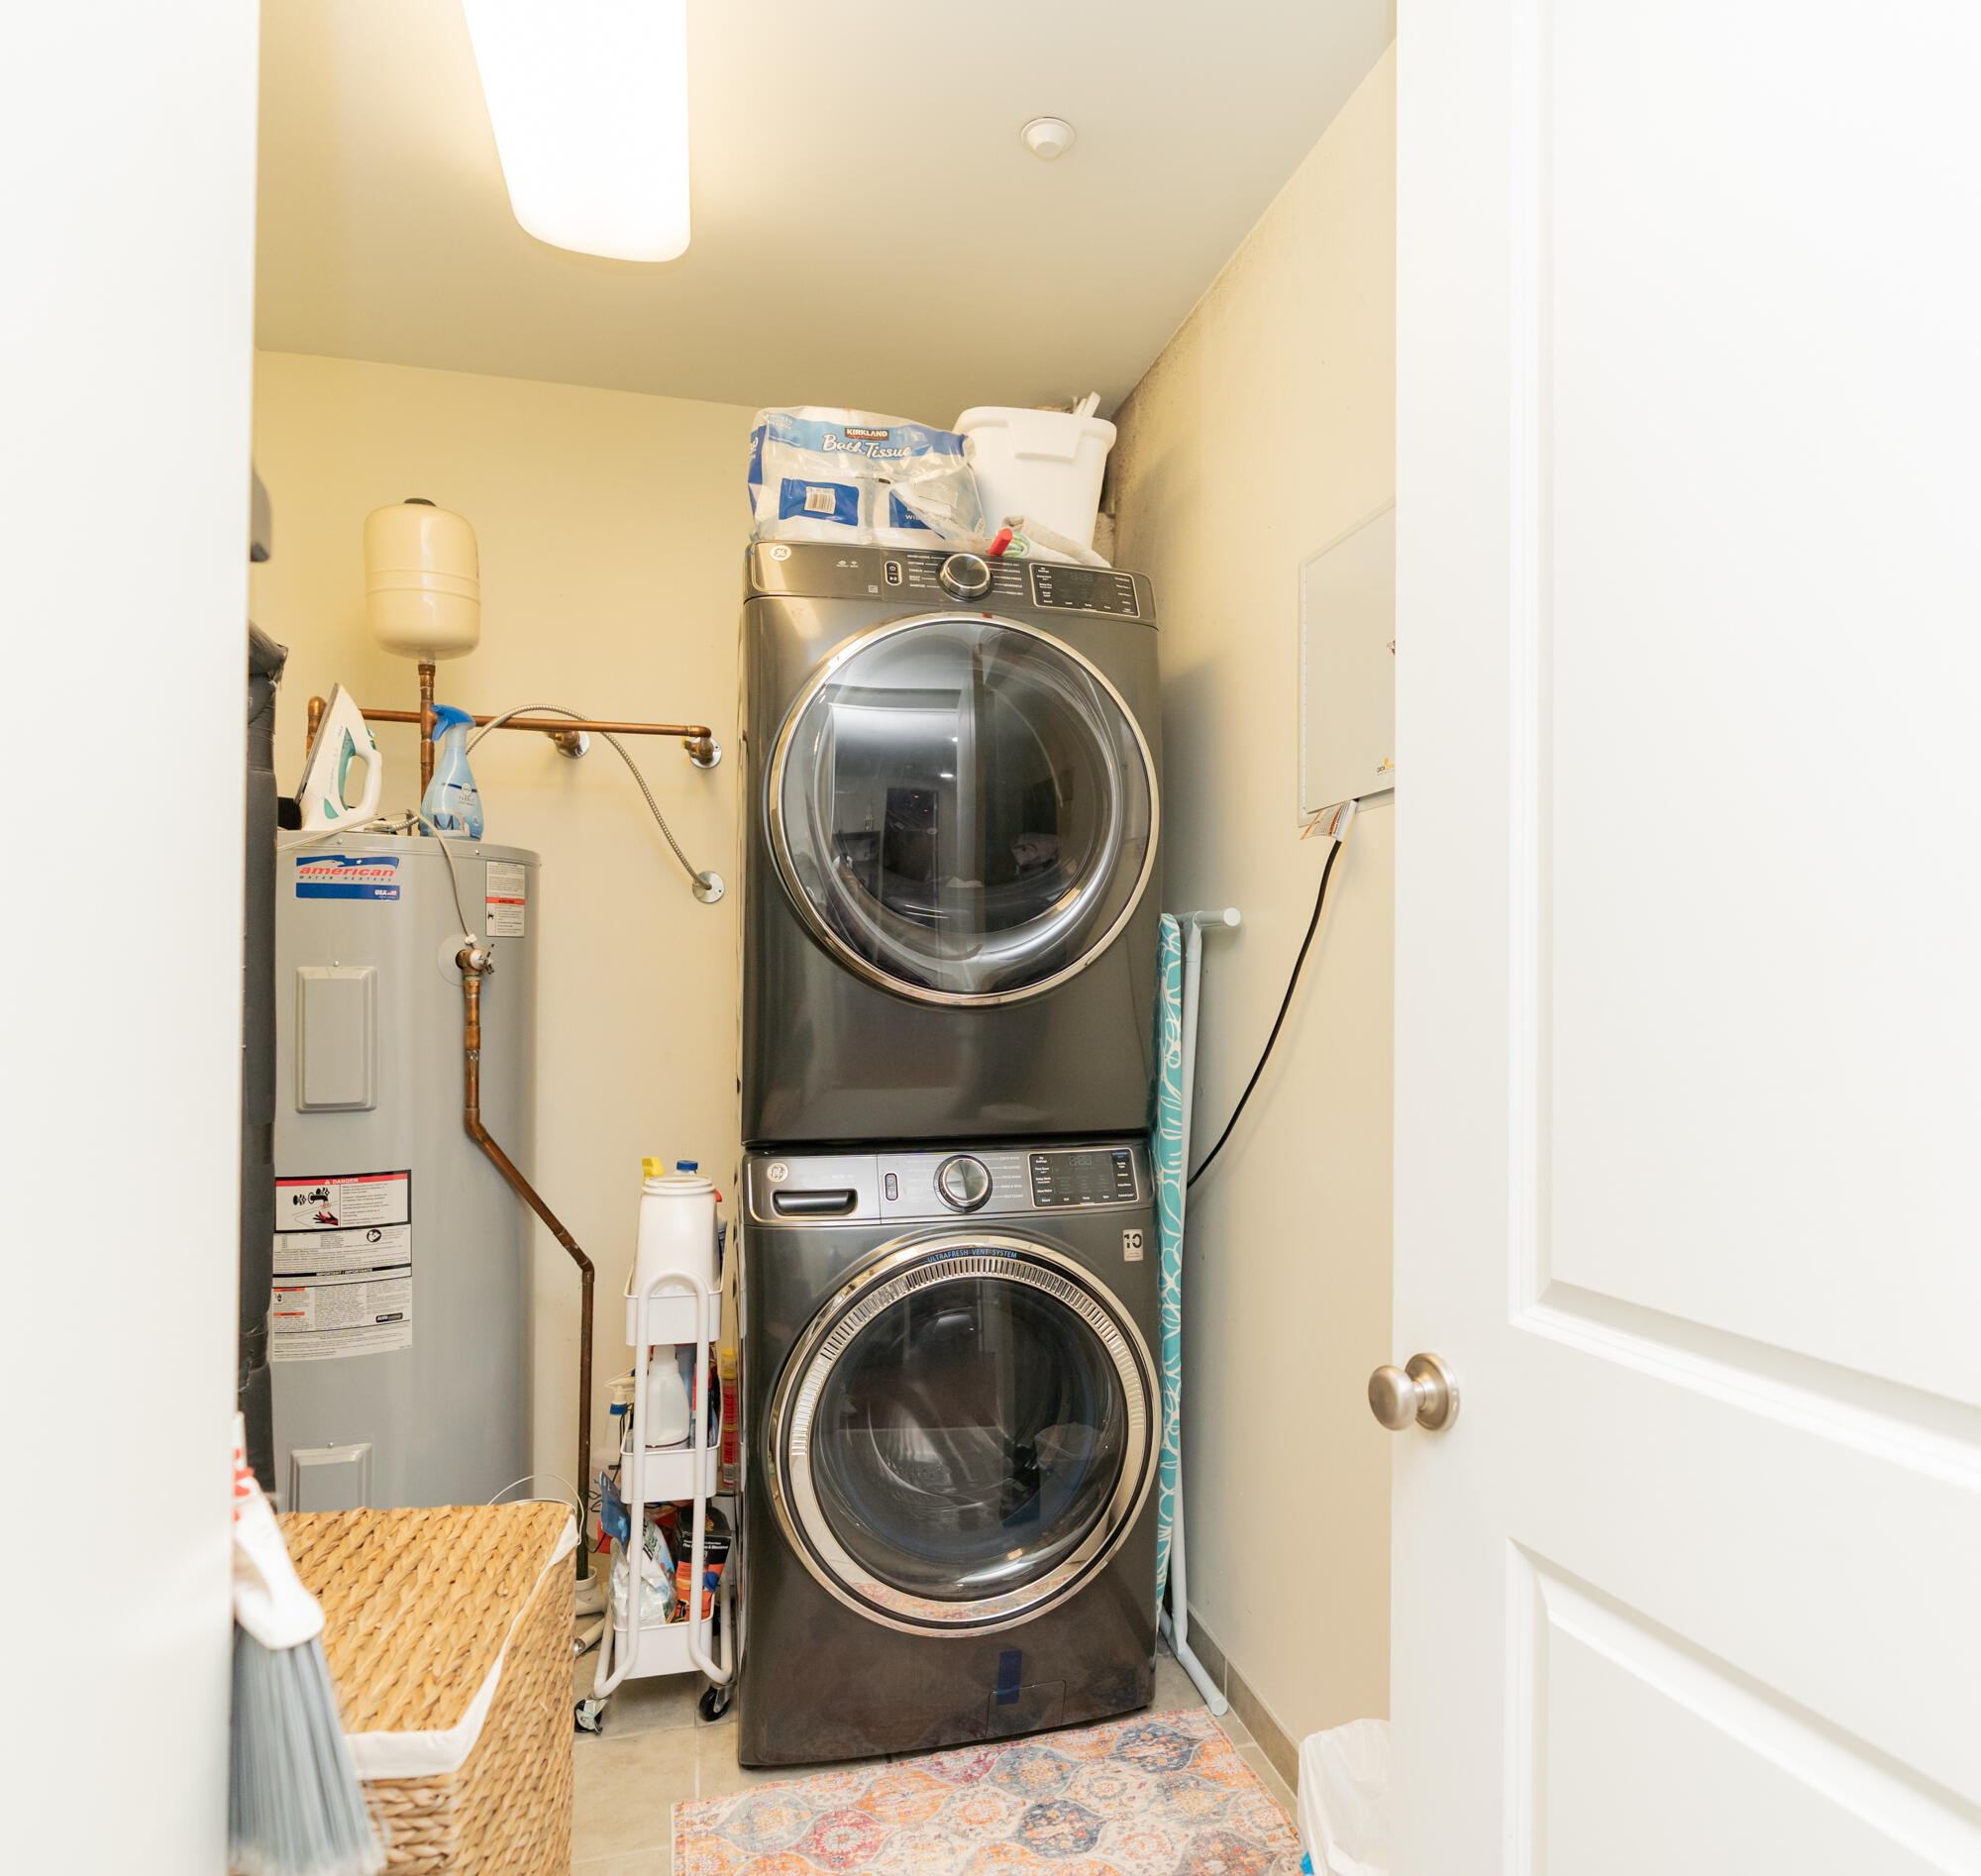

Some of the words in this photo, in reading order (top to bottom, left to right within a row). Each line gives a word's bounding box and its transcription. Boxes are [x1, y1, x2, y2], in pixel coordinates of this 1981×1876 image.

[846, 428, 888, 438] KIRKLAND
[822, 434, 864, 455] Bath
[863, 443, 912, 460] Tissue
[299, 867, 395, 877] american
[926, 1249, 969, 1263] ULTRAFRESH
[991, 1249, 1017, 1258] SYSTEM
